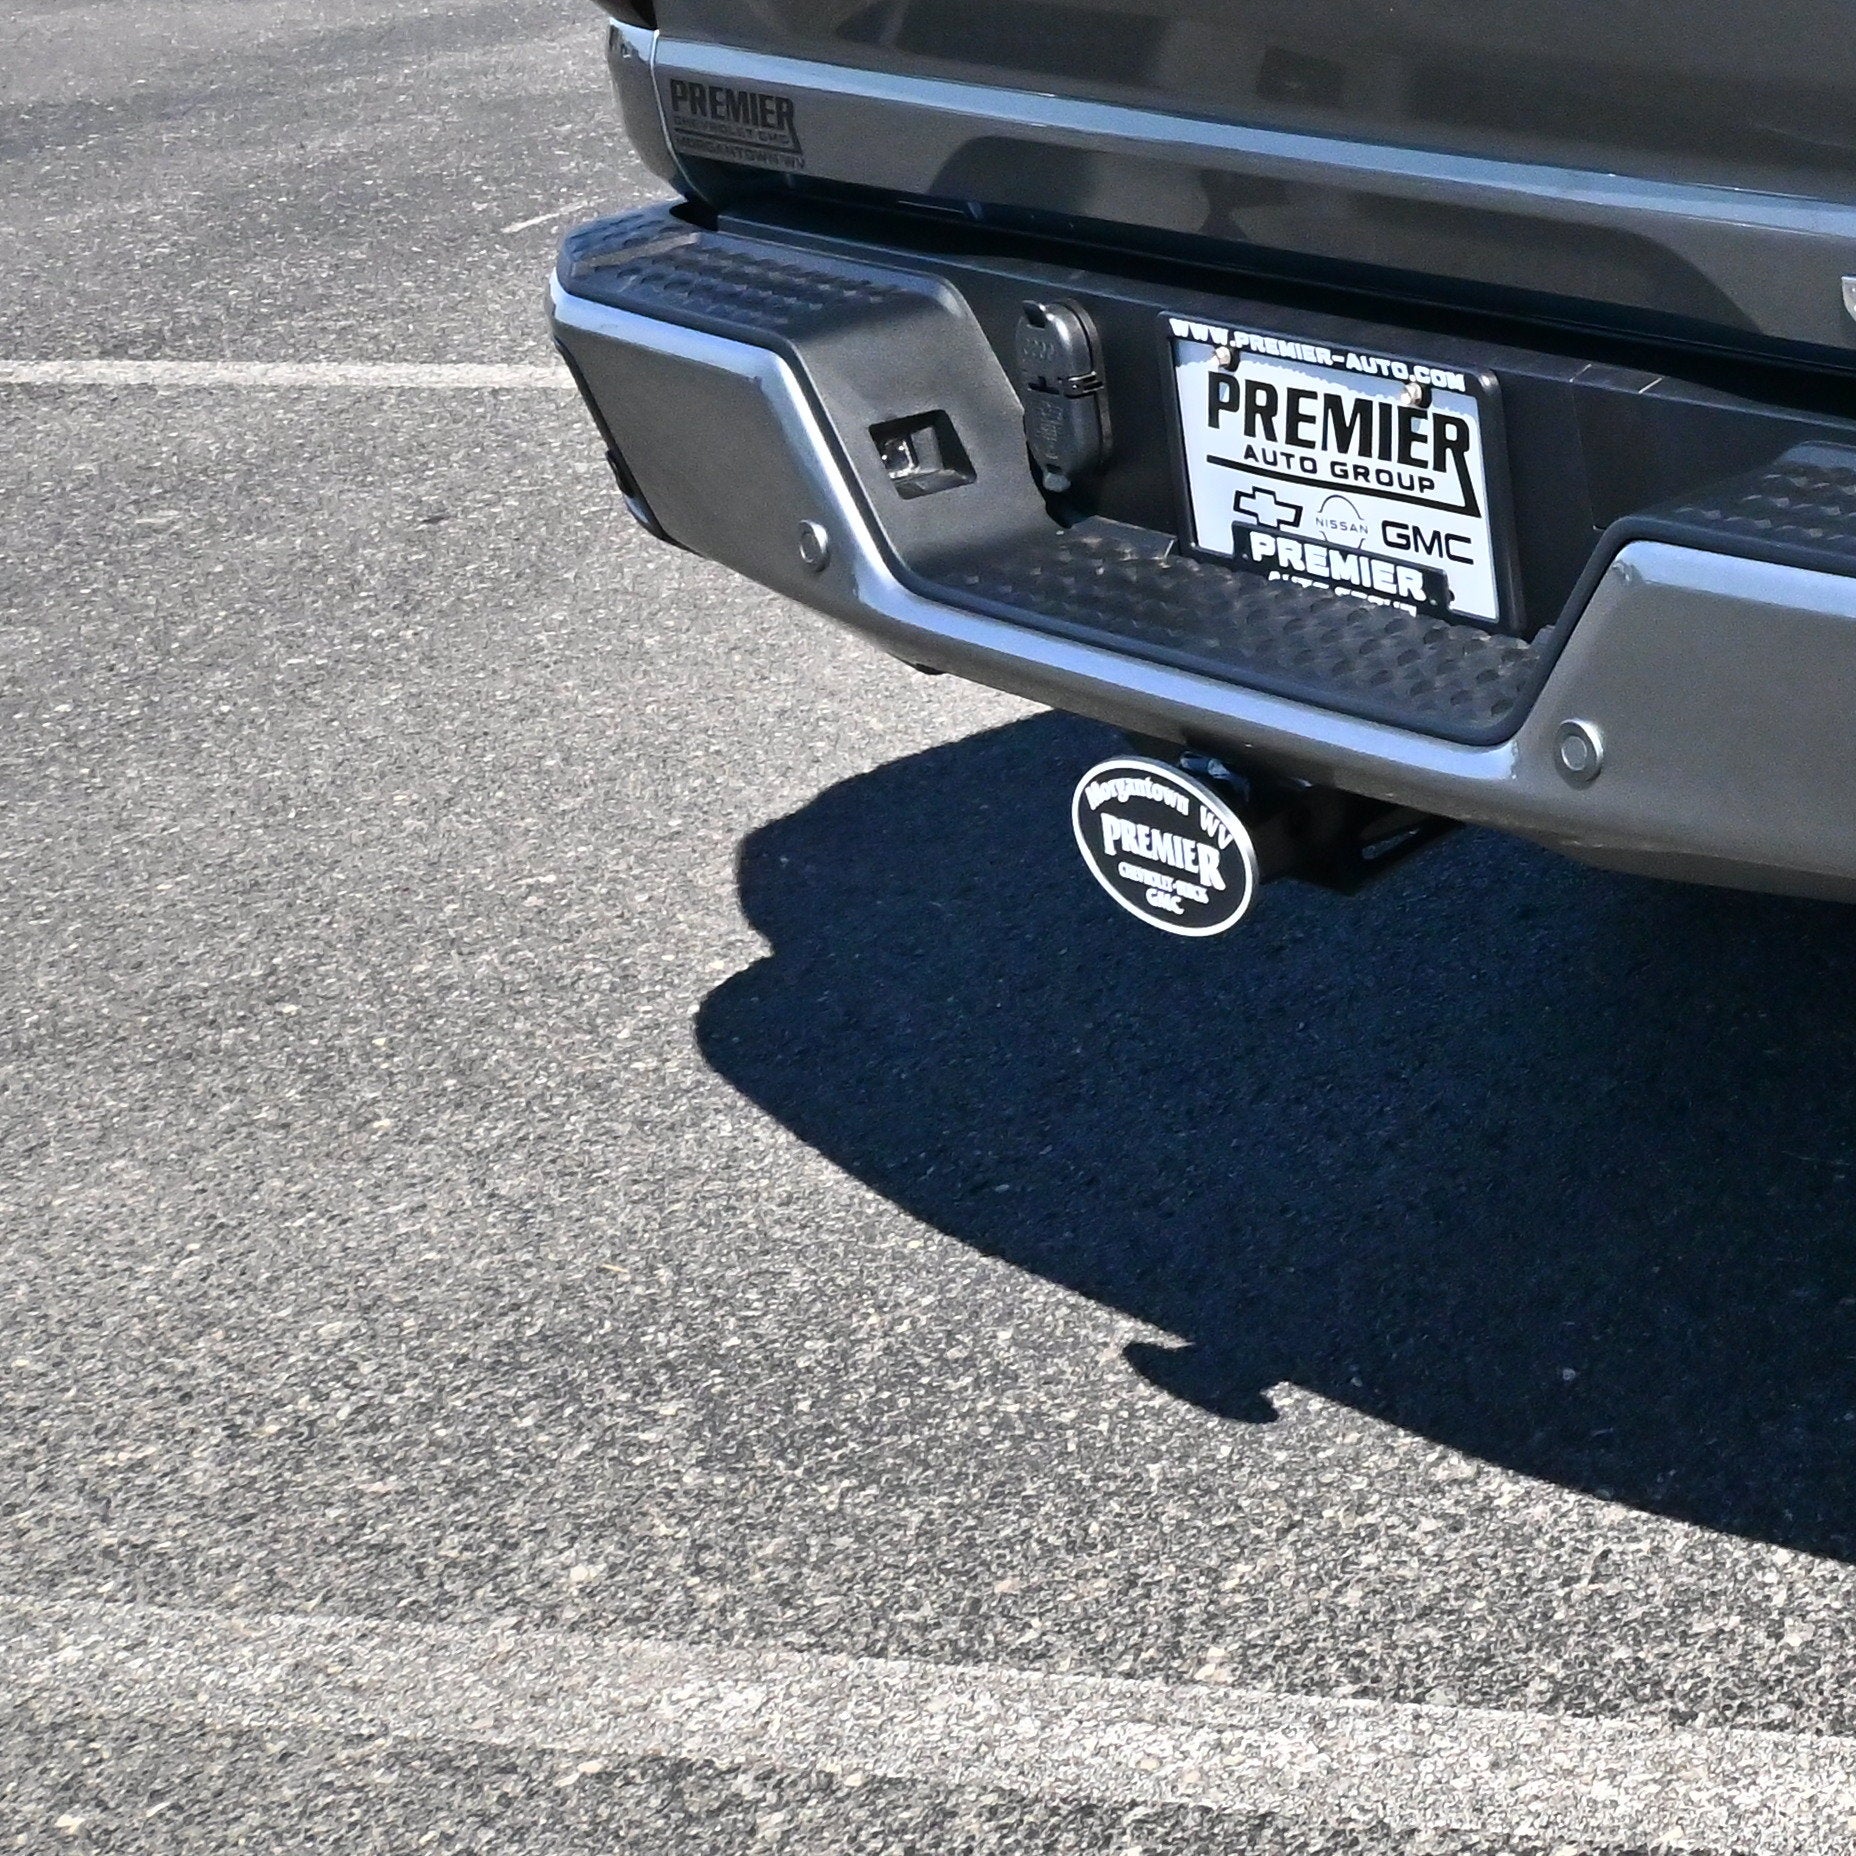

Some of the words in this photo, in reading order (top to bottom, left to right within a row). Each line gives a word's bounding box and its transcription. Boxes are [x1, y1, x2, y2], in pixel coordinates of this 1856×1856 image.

[670, 78, 798, 135] PREMIER
[1168, 318, 1467, 392] WWW.PREMIER-AUTO.COM
[1207, 370, 1476, 486] PREMIER
[1243, 444, 1319, 475] AUTO
[1329, 460, 1435, 493] GROUP
[1314, 515, 1370, 535] NISSAN
[1381, 519, 1475, 565] GMC
[1249, 531, 1427, 602] PREMIER
[1100, 812, 1226, 892] PREMIER
[1199, 804, 1234, 850] WV
[1145, 888, 1185, 915] GMC
